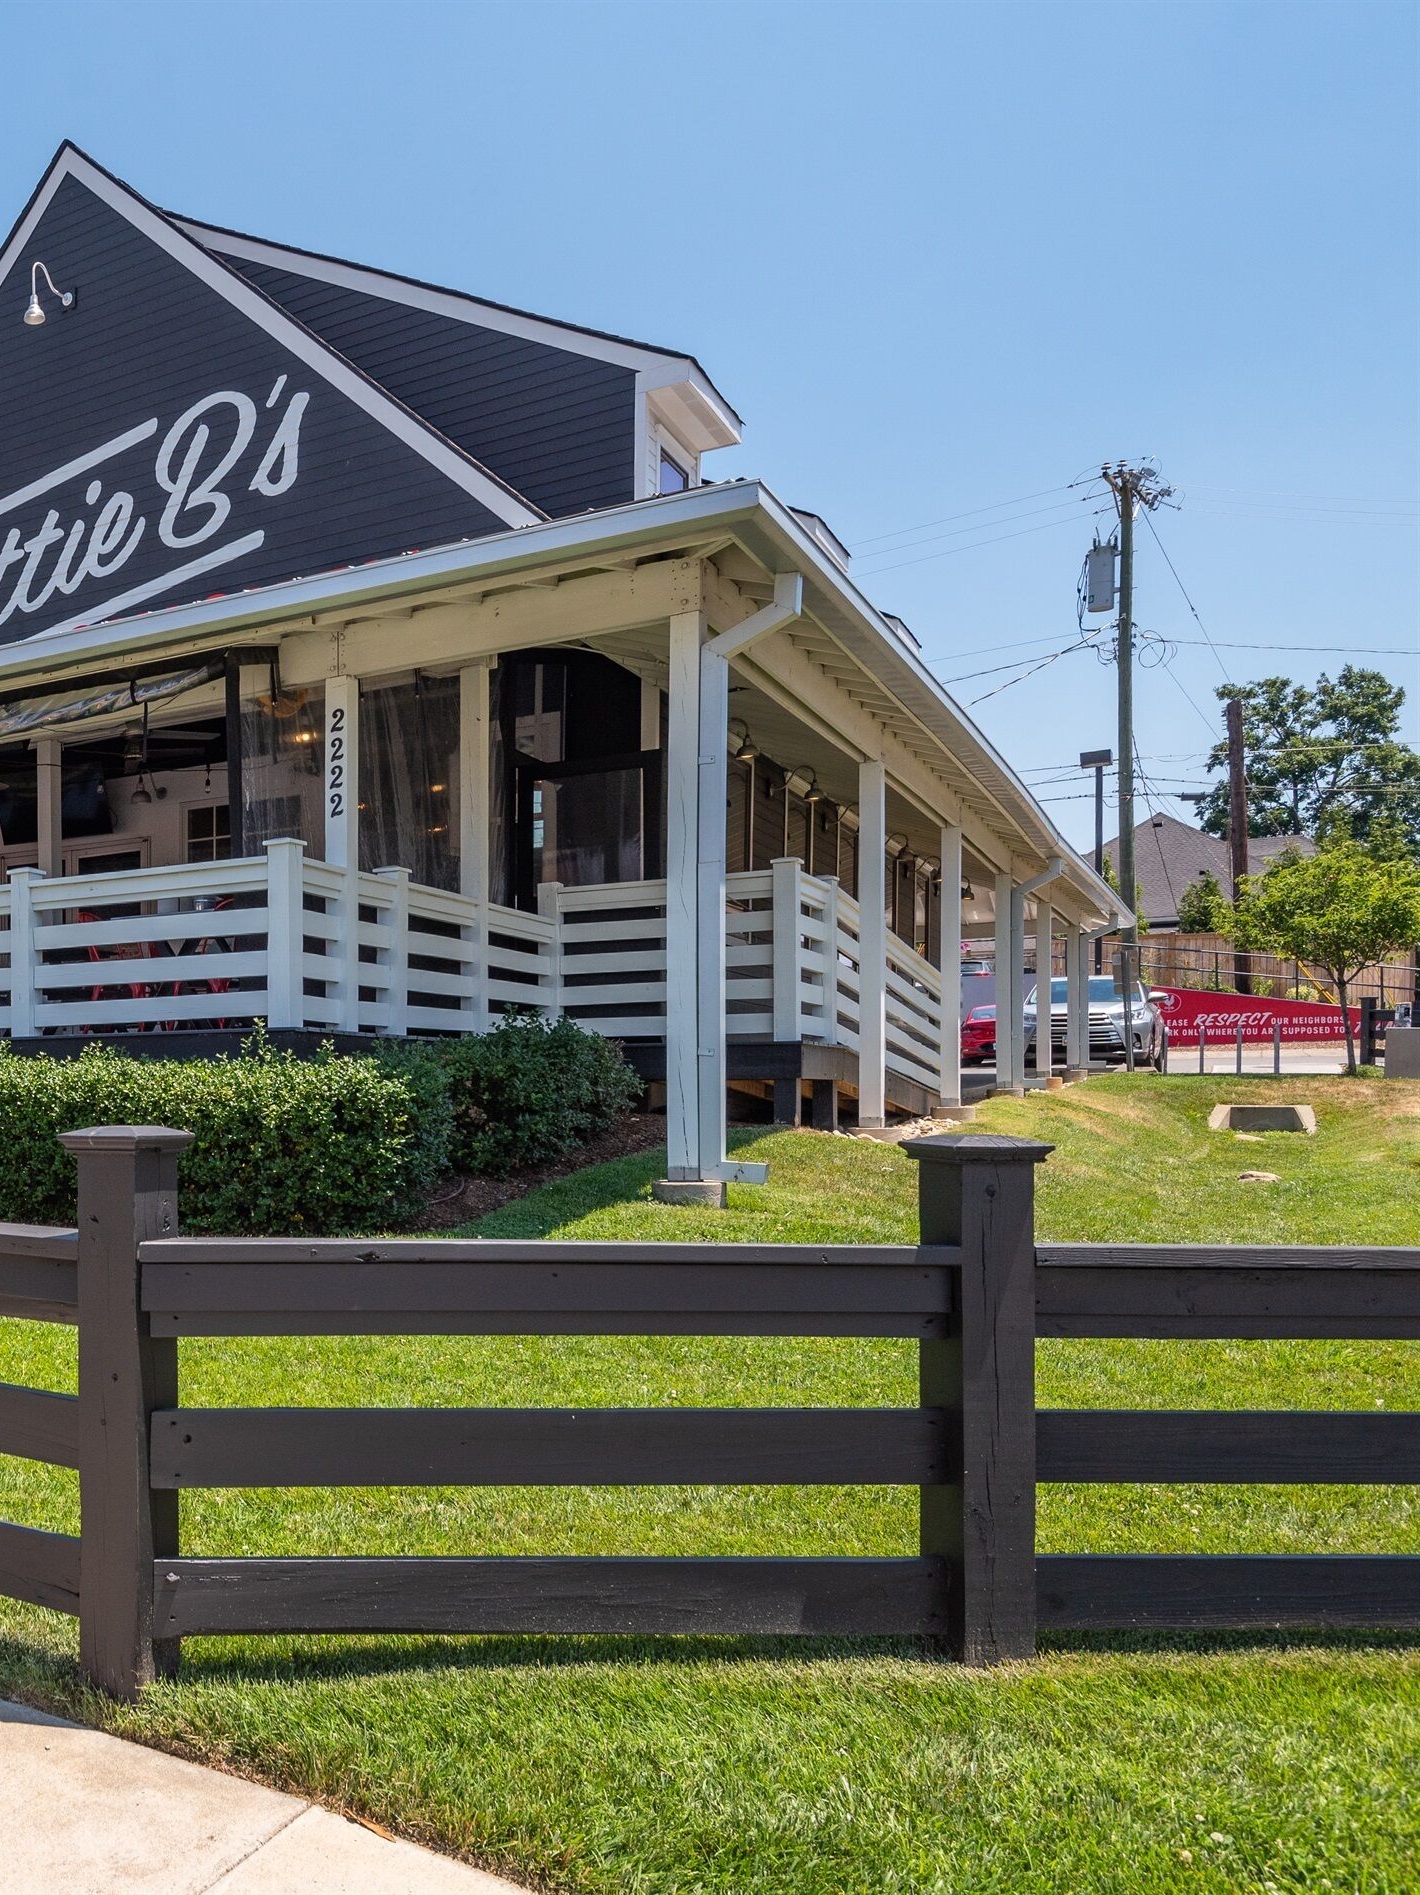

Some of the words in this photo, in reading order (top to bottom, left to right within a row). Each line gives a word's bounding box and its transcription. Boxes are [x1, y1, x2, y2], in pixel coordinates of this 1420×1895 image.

[154, 374, 311, 549] B's
[330, 708, 345, 818] 2222
[1193, 1012, 1273, 1026] RESPECT
[1271, 1017, 1289, 1025] OUR
[1292, 1016, 1345, 1025] NEIGHBORS
[1206, 1028, 1238, 1036] WHERE
[1241, 1027, 1258, 1036] YOU
[1261, 1027, 1274, 1035] AR
[1282, 1026, 1330, 1035] SUPPOSED
[1333, 1026, 1346, 1034] TO
